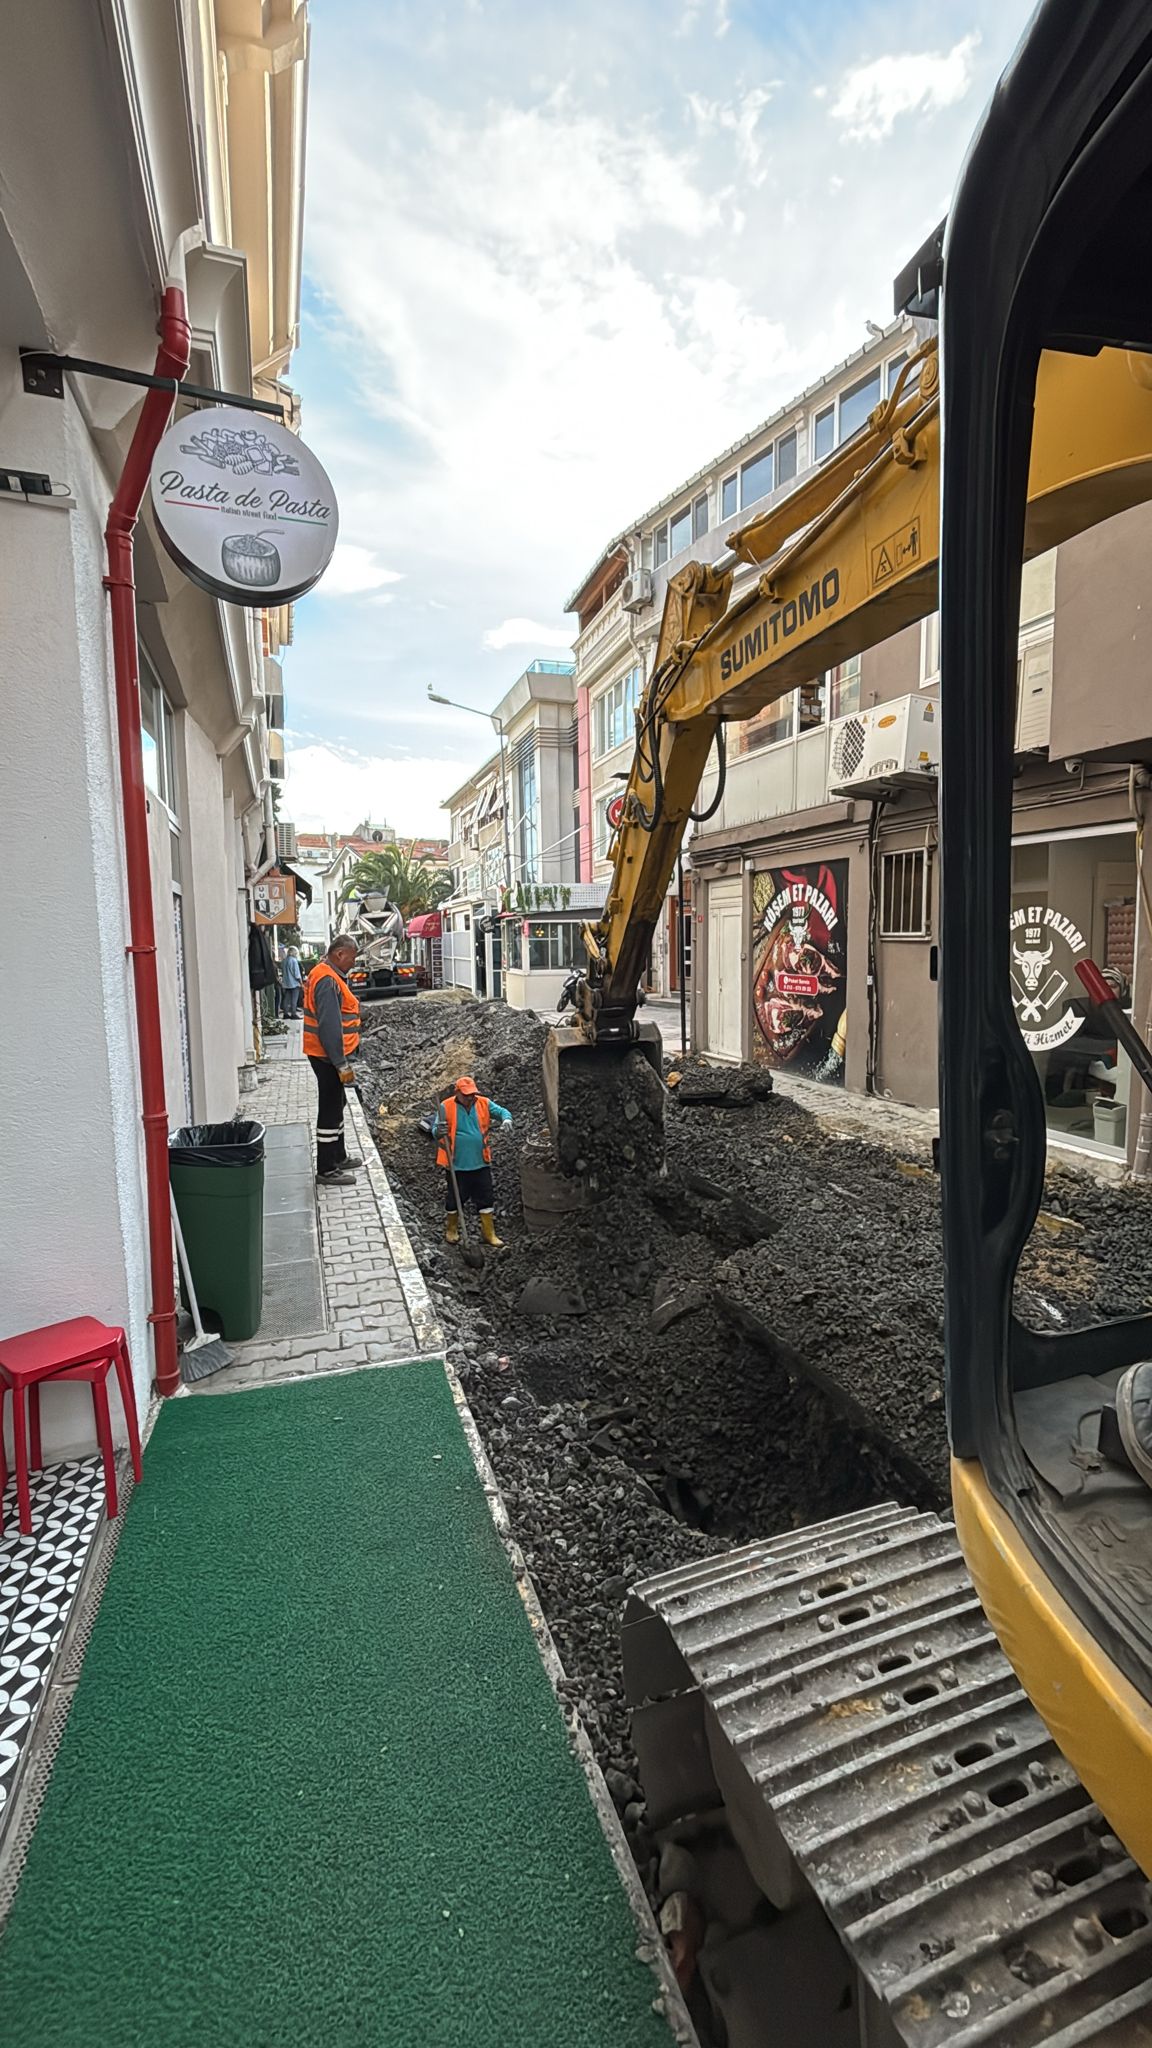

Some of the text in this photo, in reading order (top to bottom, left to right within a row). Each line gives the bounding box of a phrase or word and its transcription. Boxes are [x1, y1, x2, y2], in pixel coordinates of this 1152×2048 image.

[159, 470, 331, 519] Pasta de Pasta
[720, 568, 840, 681] SUMITOMO
[763, 883, 839, 932] KÖŞEM ET PAZARI
[1028, 906, 1043, 924] ET
[1043, 908, 1087, 954] PAZARI
[1025, 928, 1042, 938] 1977
